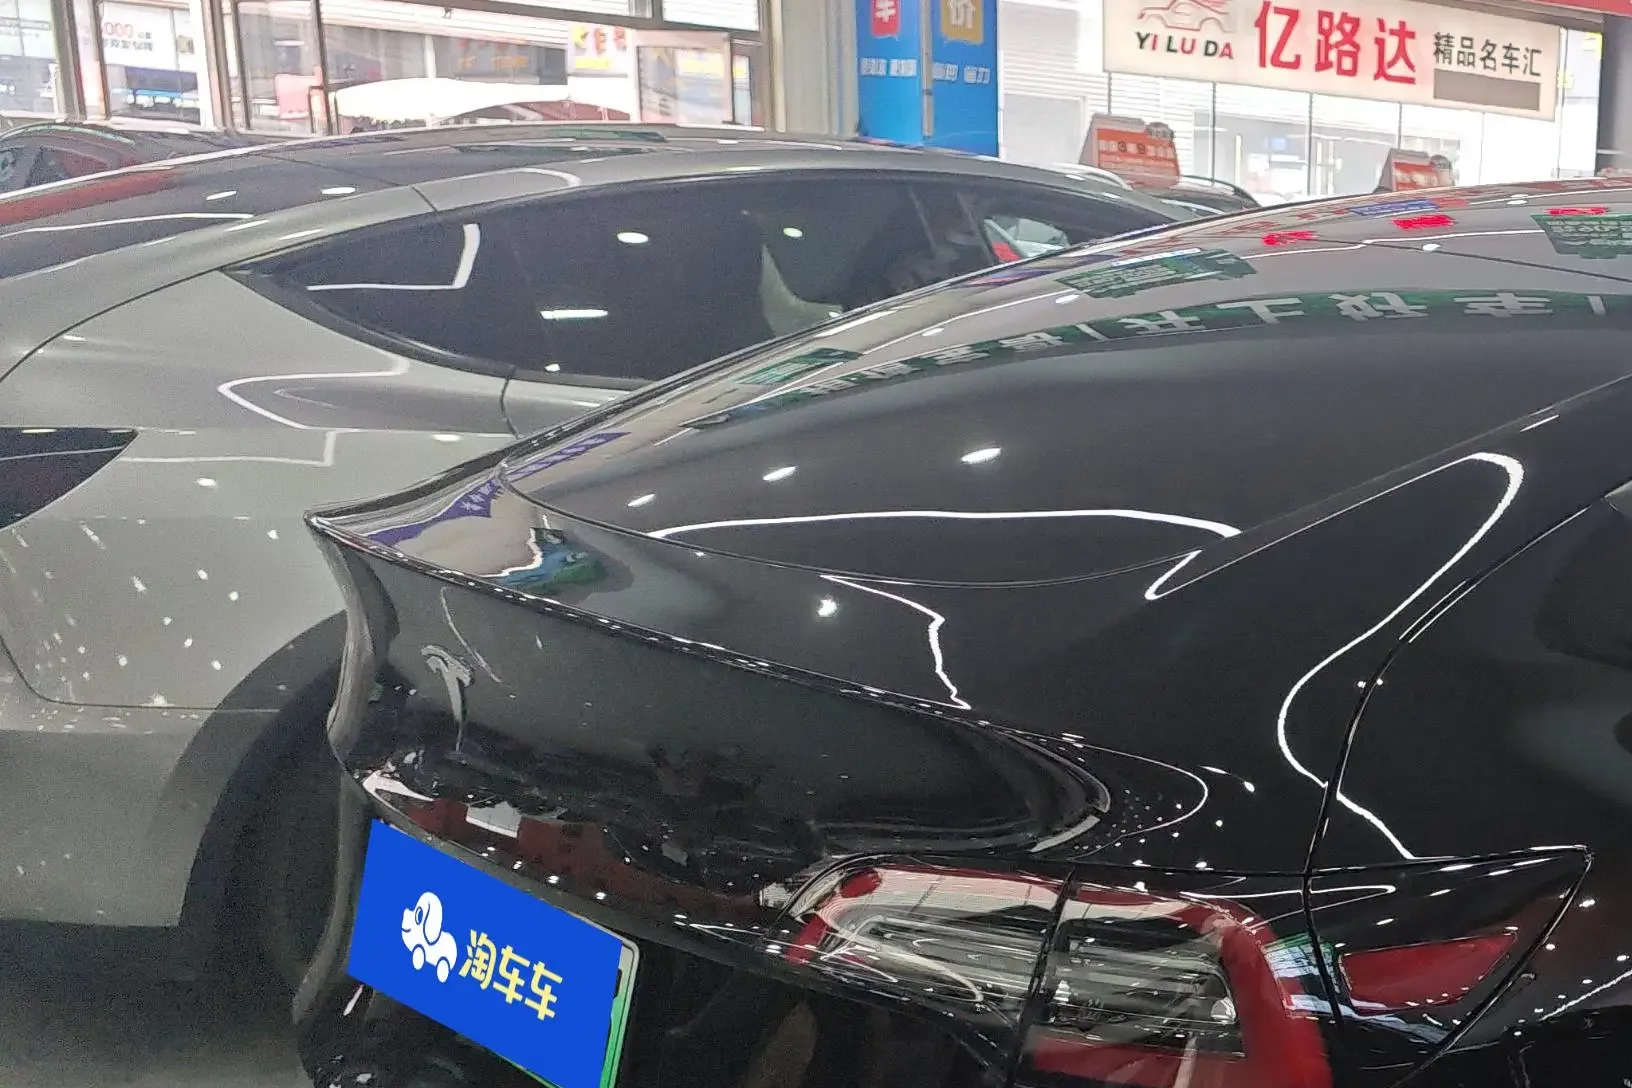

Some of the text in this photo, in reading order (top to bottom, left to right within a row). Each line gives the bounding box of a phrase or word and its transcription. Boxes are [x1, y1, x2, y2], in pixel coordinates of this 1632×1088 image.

[1254, 1, 1417, 84] 亿路达
[1433, 32, 1541, 77] 精品名车汇
